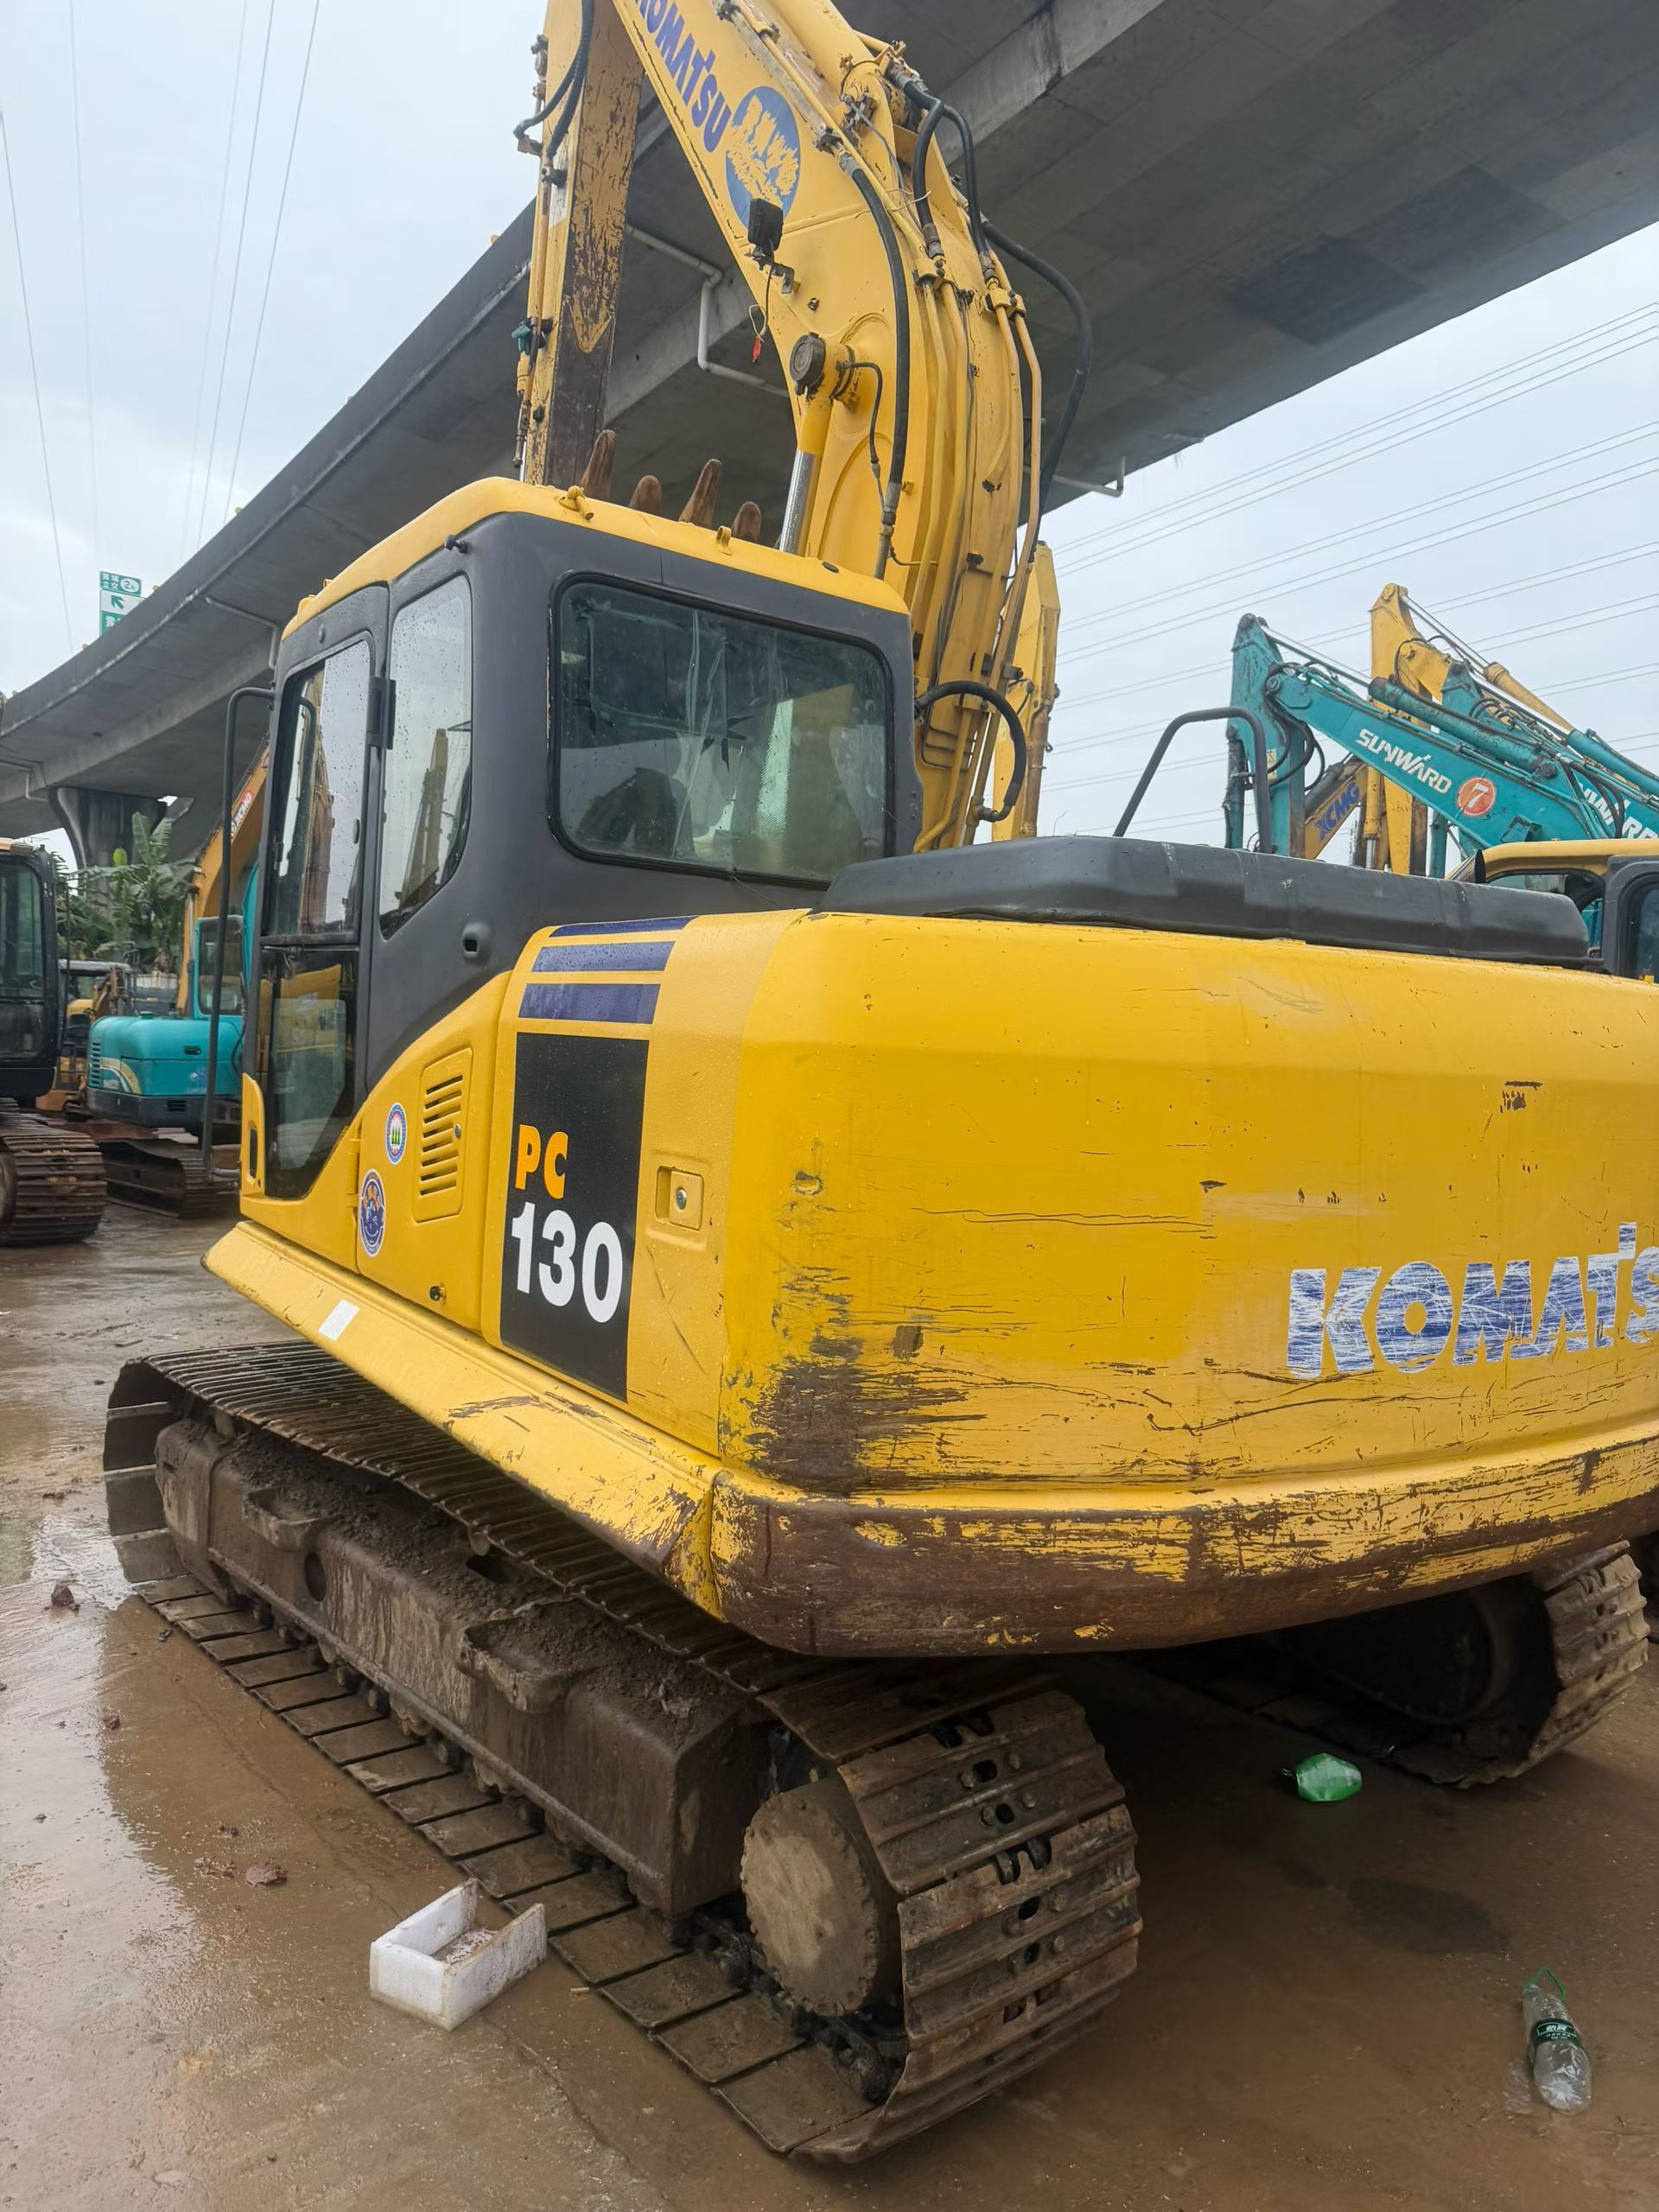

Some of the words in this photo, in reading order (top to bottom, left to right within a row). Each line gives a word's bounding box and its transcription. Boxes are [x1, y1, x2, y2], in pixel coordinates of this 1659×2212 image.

[634, 0, 732, 153] OMATSU
[1315, 780, 1360, 841] XCMG
[1467, 782, 1490, 809] 7
[515, 1123, 569, 1199] PC
[512, 1201, 623, 1323] 130
